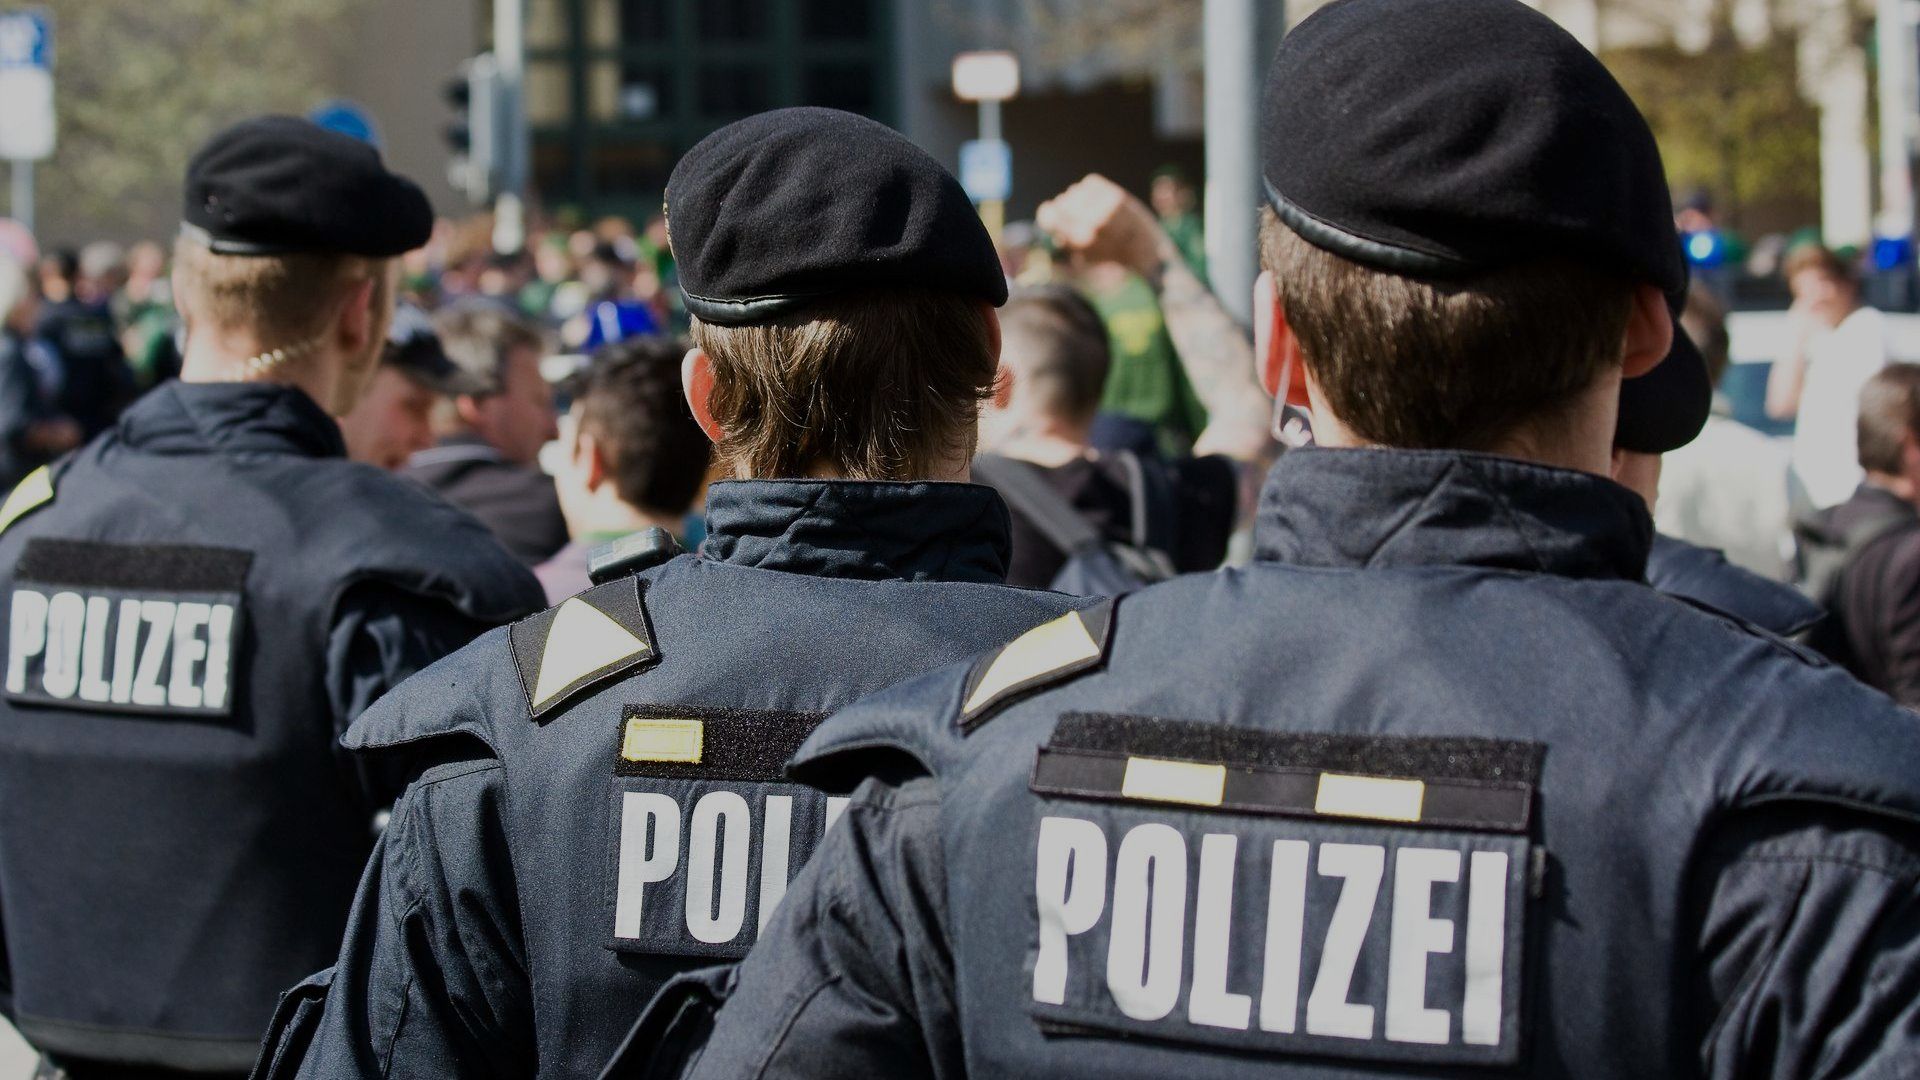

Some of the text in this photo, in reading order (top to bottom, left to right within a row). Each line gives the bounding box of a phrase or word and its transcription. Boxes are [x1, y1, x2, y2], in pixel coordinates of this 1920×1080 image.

[6, 590, 233, 708] POLIZEI
[615, 791, 850, 943] POL
[1033, 816, 1508, 1046] POLIZEI
